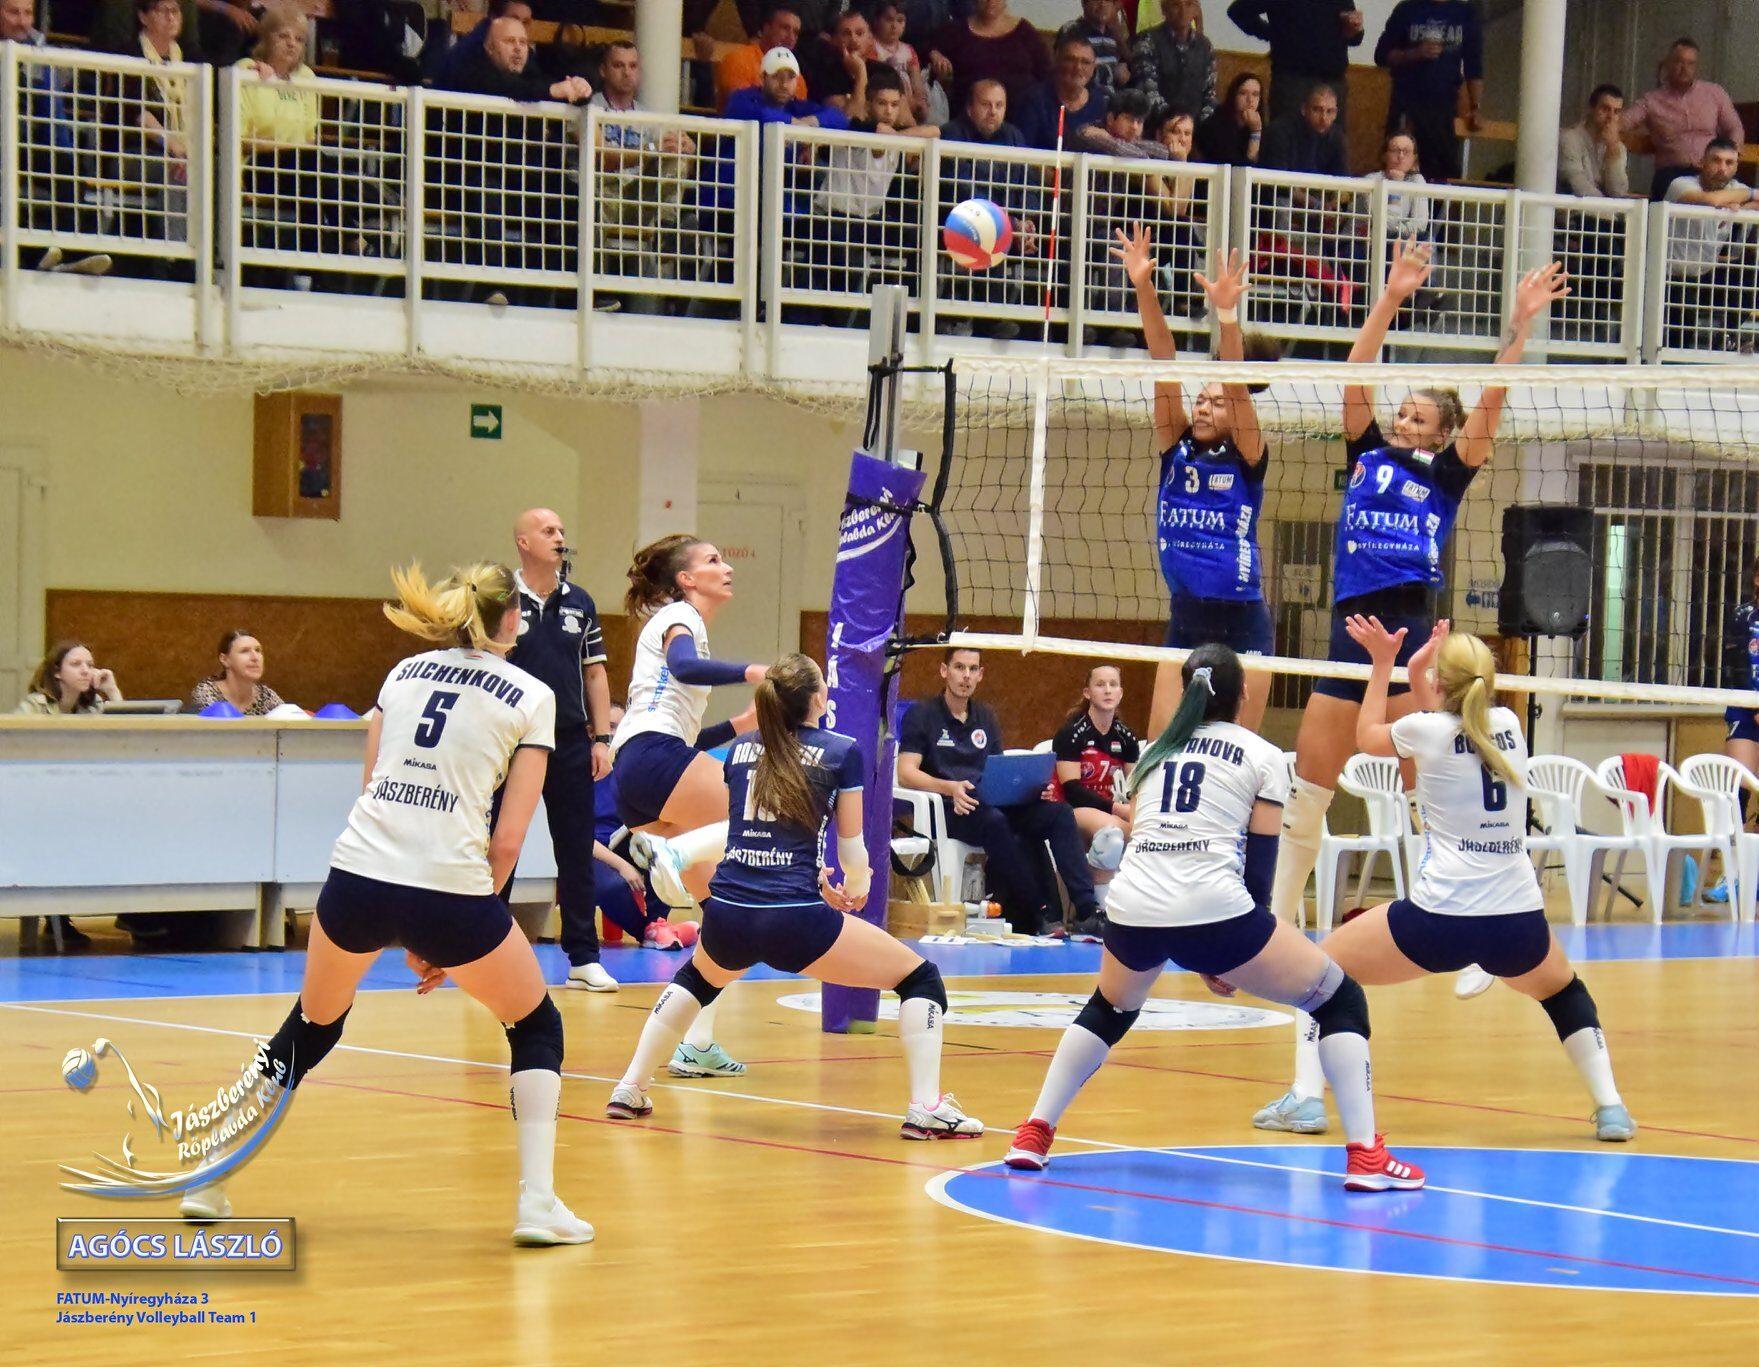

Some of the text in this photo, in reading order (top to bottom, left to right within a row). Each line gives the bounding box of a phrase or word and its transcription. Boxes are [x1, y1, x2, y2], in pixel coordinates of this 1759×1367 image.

[1184, 465, 1201, 494] 3
[1376, 464, 1394, 494] 9
[1160, 500, 1226, 526] FATUM
[1346, 502, 1420, 529] FATUM
[396, 660, 525, 708] SILCHENKOVA
[413, 690, 461, 749] 5
[1098, 760, 1110, 782] 7
[373, 776, 458, 813] JÁSZBERÉNY
[1160, 761, 1206, 813] 18
[1481, 762, 1508, 812] 6
[927, 1002, 939, 1030] MIKASA
